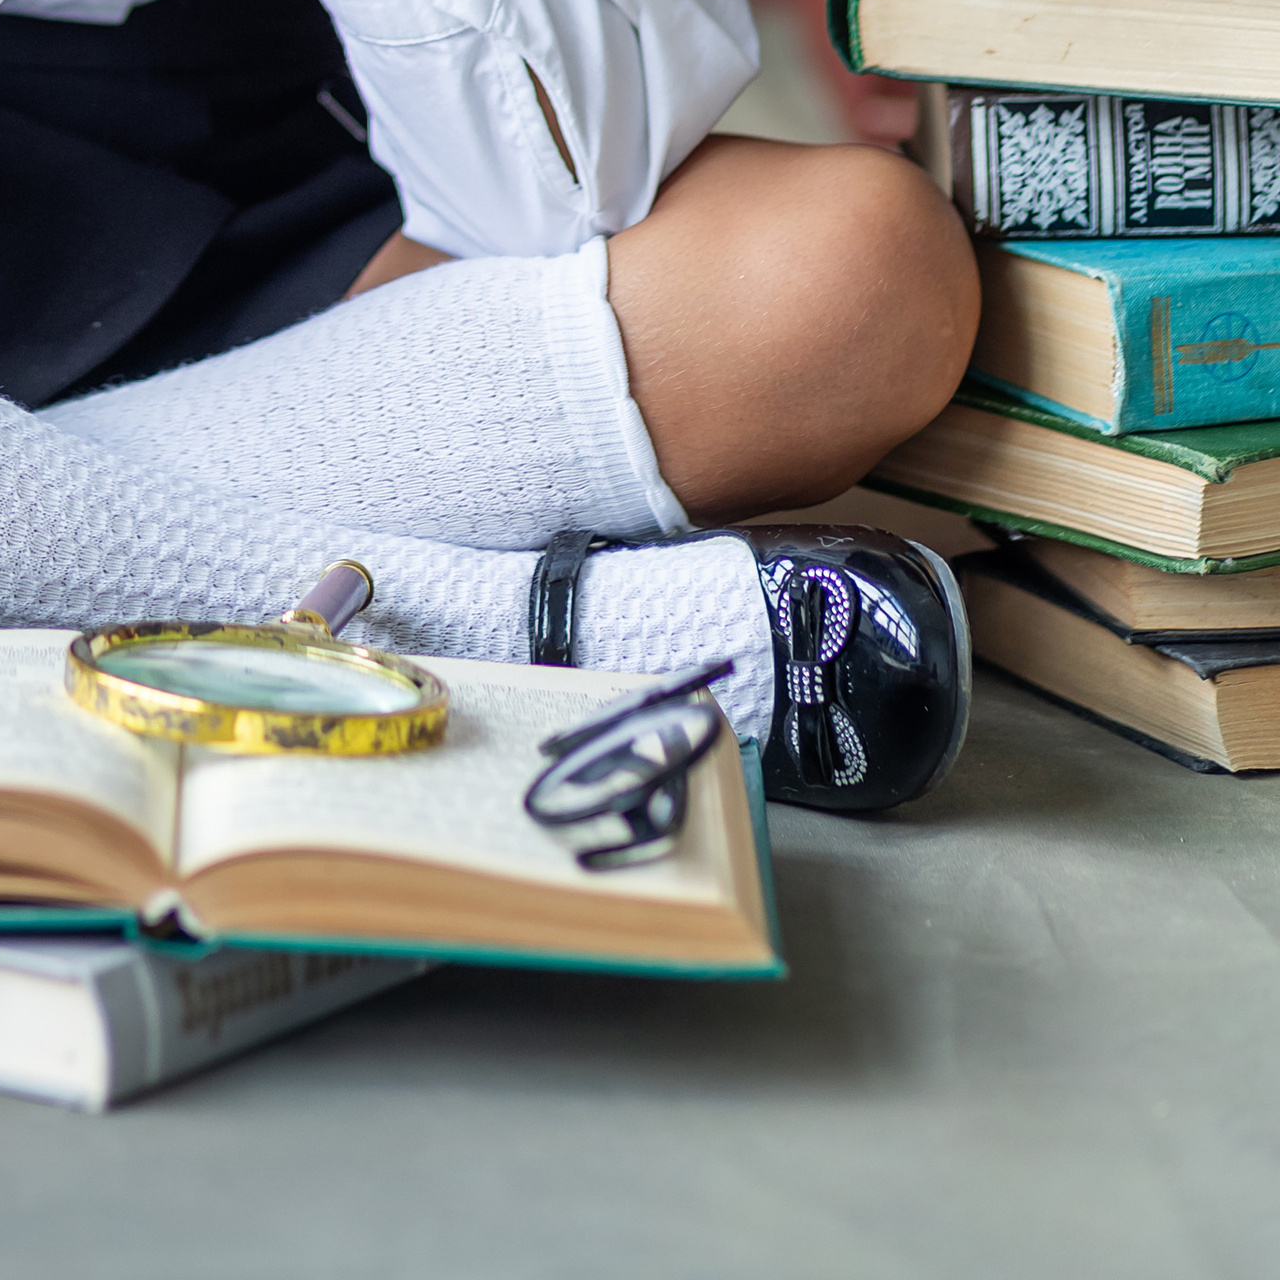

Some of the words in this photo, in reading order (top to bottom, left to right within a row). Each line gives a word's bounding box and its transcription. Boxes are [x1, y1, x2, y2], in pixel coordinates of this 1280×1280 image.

[1149, 115, 1185, 210] ВОЙНА
[1181, 116, 1213, 181] МИР
[1181, 188, 1213, 210] И
